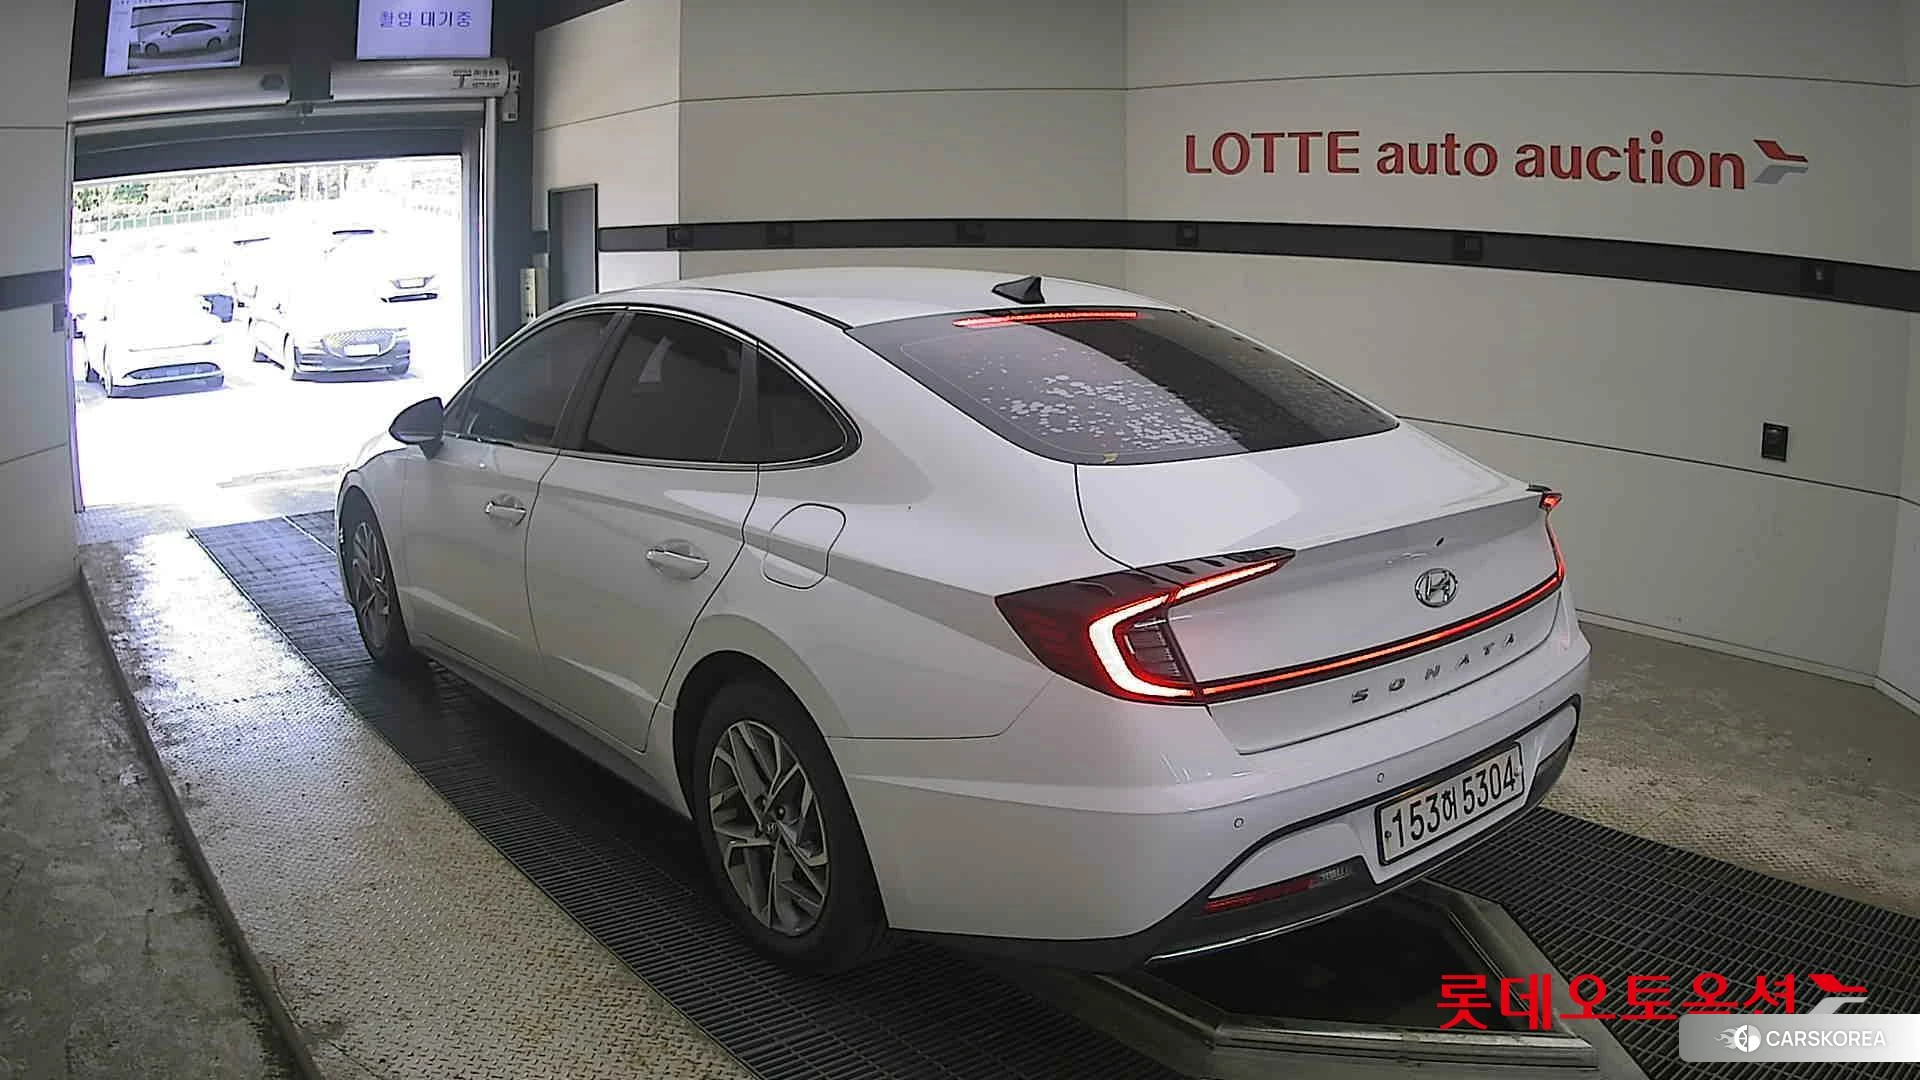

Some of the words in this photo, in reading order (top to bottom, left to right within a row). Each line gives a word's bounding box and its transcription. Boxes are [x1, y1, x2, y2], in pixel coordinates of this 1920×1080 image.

[420, 9, 473, 29] 대기중
[1185, 131, 1361, 175] LOTTE
[1376, 132, 1498, 178] auto
[1514, 130, 1746, 190] auction
[1351, 633, 1515, 704] SONATA
